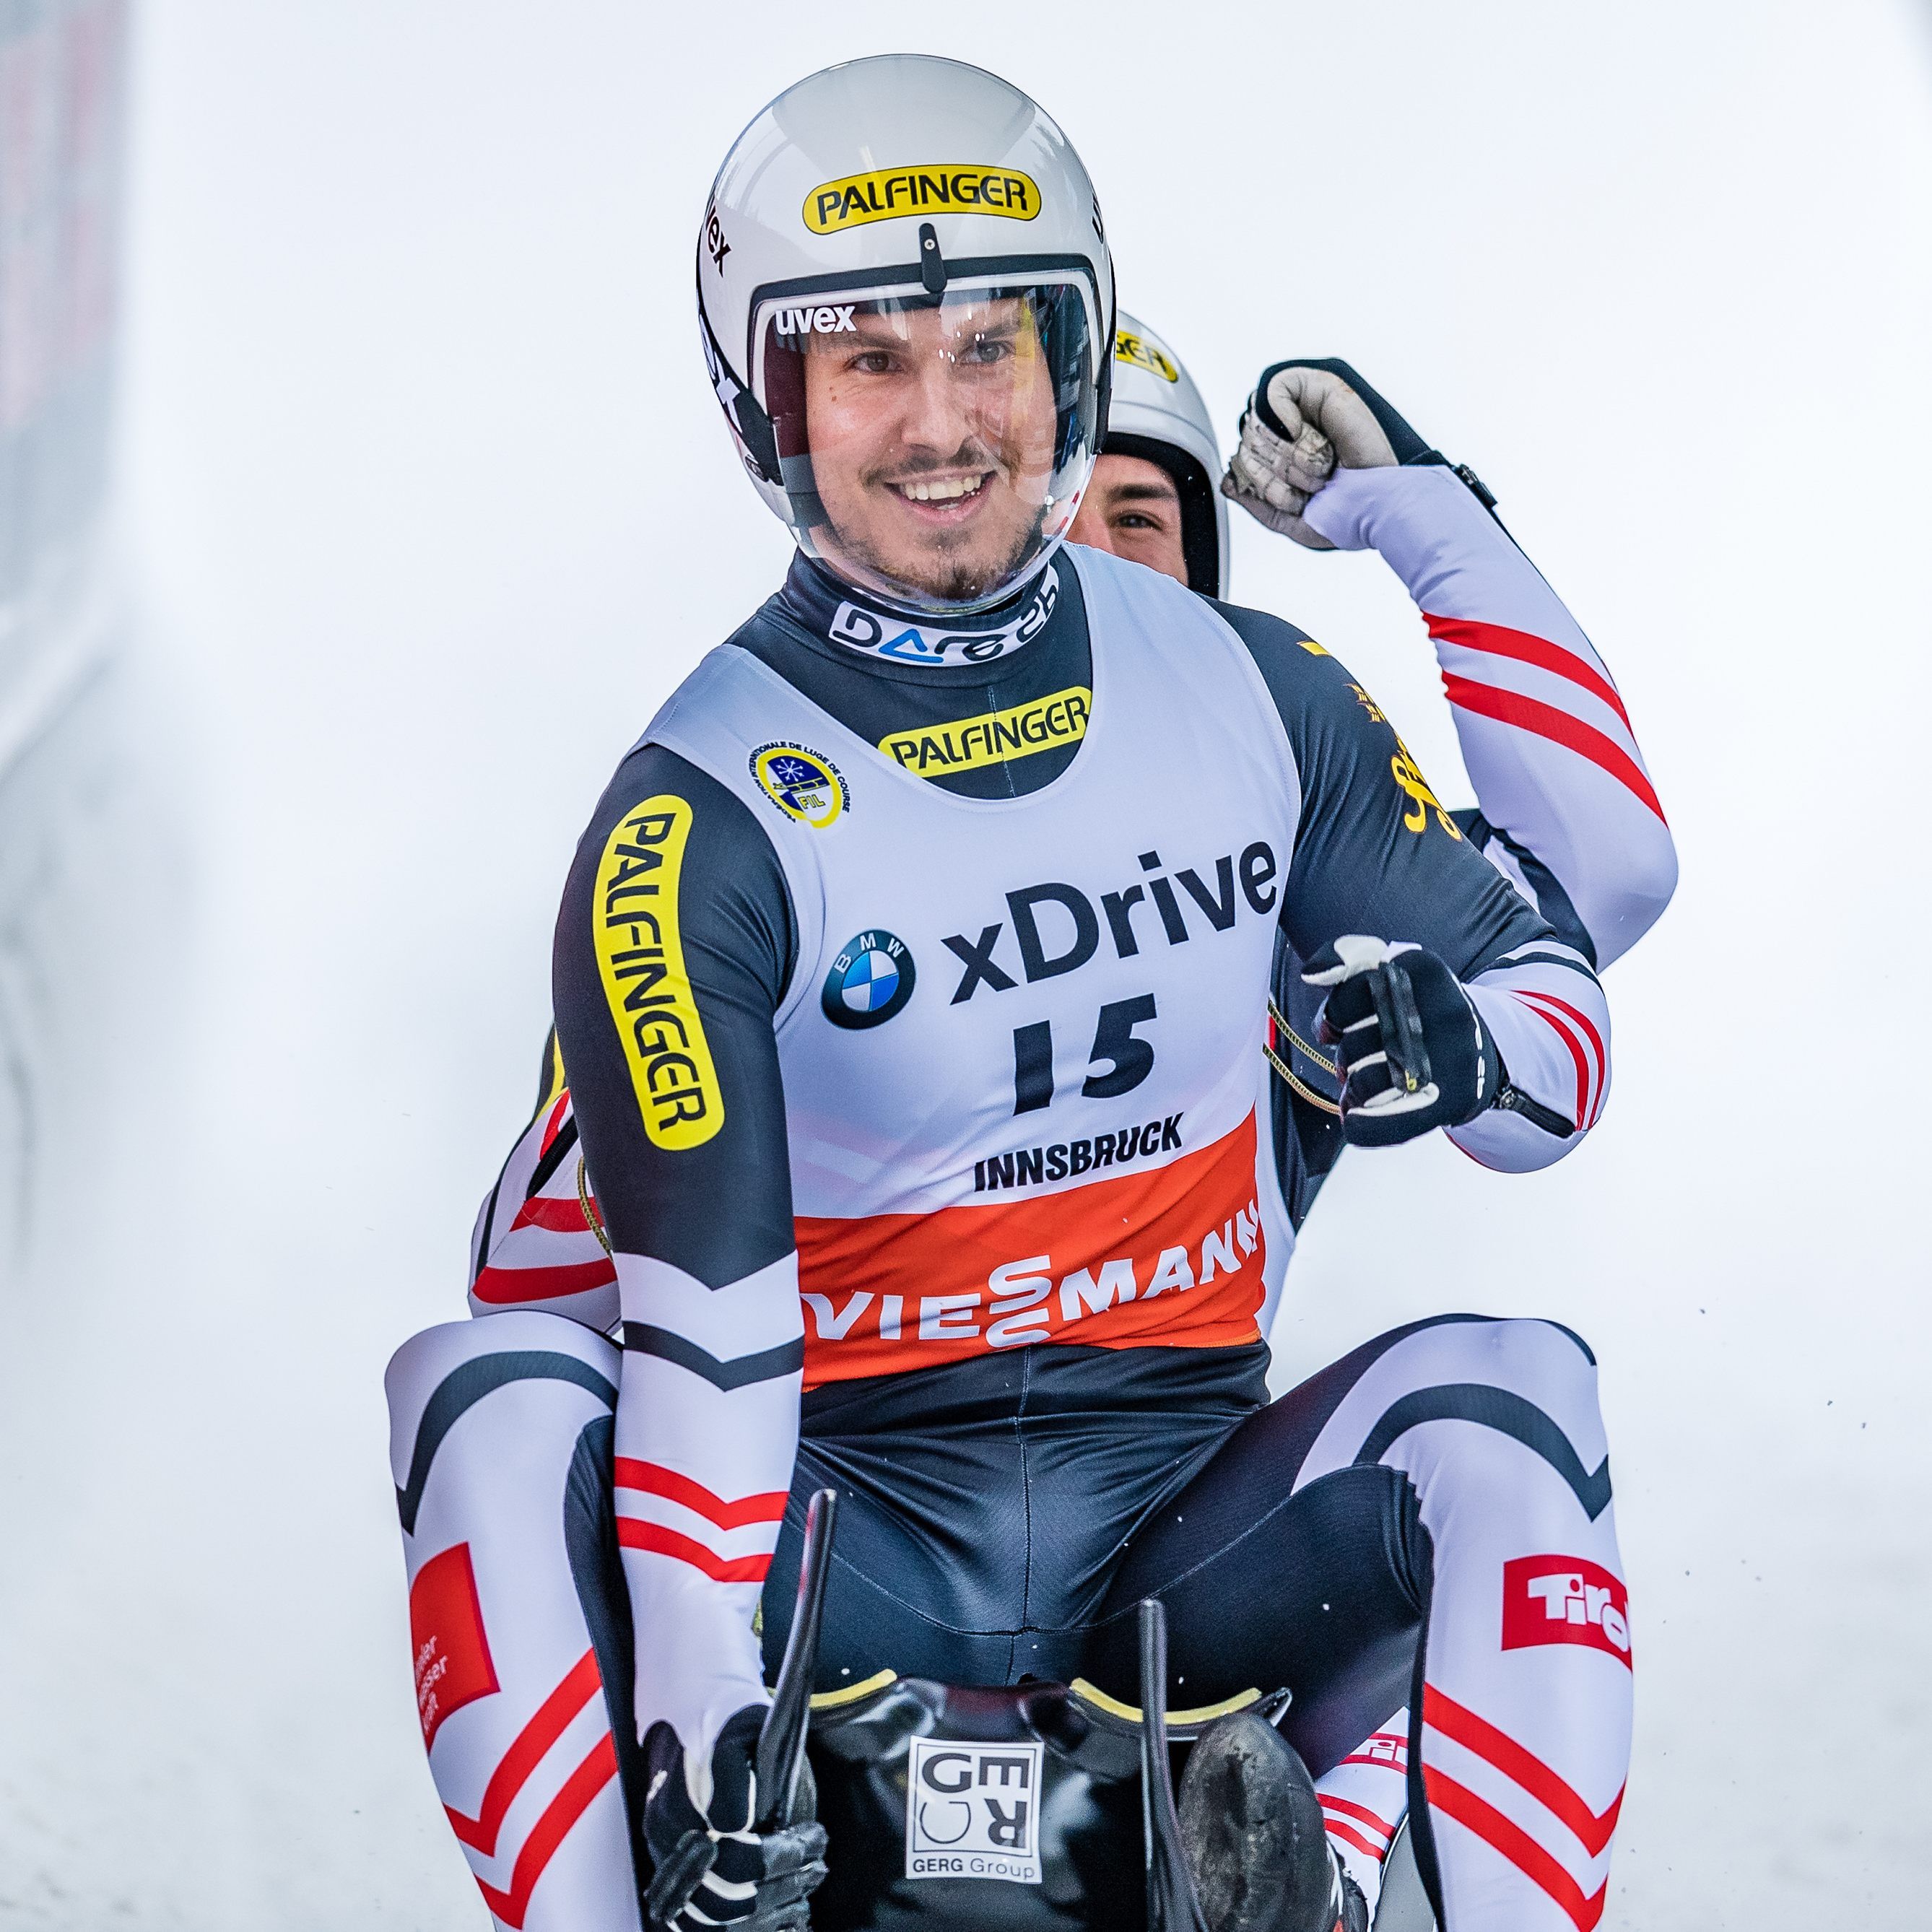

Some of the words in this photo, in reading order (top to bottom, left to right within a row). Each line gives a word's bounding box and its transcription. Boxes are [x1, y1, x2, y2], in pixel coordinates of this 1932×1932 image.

[817, 173, 1028, 225] PALFINGER
[775, 305, 857, 335] uvex
[890, 695, 1089, 770] PALFINGER
[788, 741, 802, 751] DE
[804, 747, 830, 765] LUGE
[827, 760, 841, 775] DE
[837, 775, 850, 813] COURSE
[798, 794, 826, 809] FIL
[834, 933, 905, 973] BMW
[940, 841, 1277, 1006] xDrive
[605, 812, 707, 1132] PALFINGER
[1012, 993, 1157, 1116] 15
[973, 1111, 1184, 1192] INNSBRUCK
[1528, 1573, 1630, 1652] Tiro
[913, 1858, 963, 1873] GERG
[970, 1858, 1035, 1880] Group
